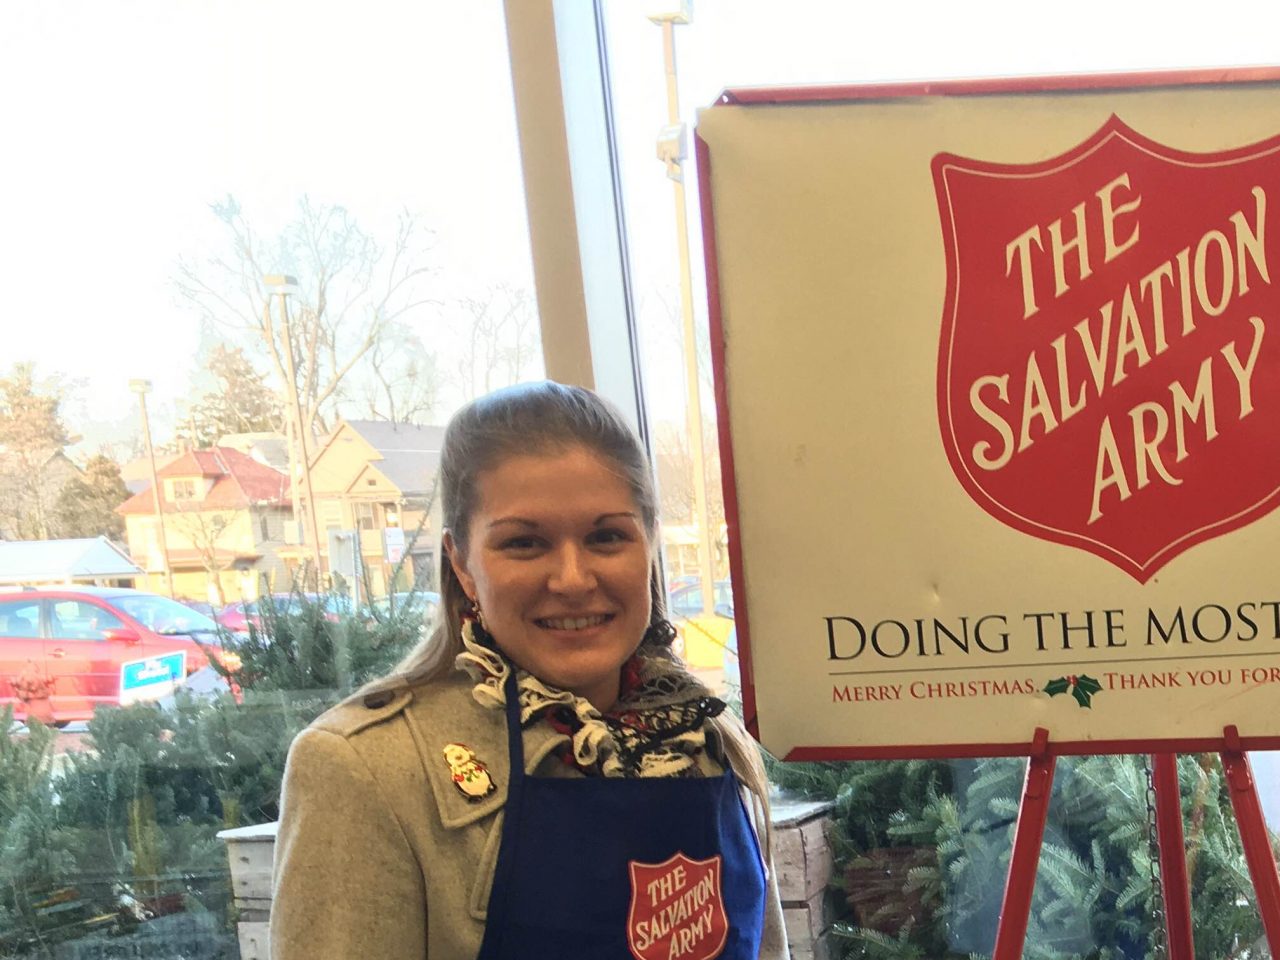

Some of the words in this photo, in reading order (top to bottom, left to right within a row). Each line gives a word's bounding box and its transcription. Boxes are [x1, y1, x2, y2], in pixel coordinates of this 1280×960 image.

[1005, 171, 1142, 321] THE
[969, 186, 1271, 471] SALVATION
[1086, 316, 1265, 525] ARMY
[822, 614, 1010, 661] DOING
[1023, 609, 1128, 651] THE
[832, 683, 903, 703] MERRY
[909, 678, 1041, 700] CHRISTMAS.
[1103, 671, 1182, 691] THANK
[1187, 669, 1232, 687] YOU
[635, 868, 715, 951] SALVATION
[647, 864, 687, 908] THE
